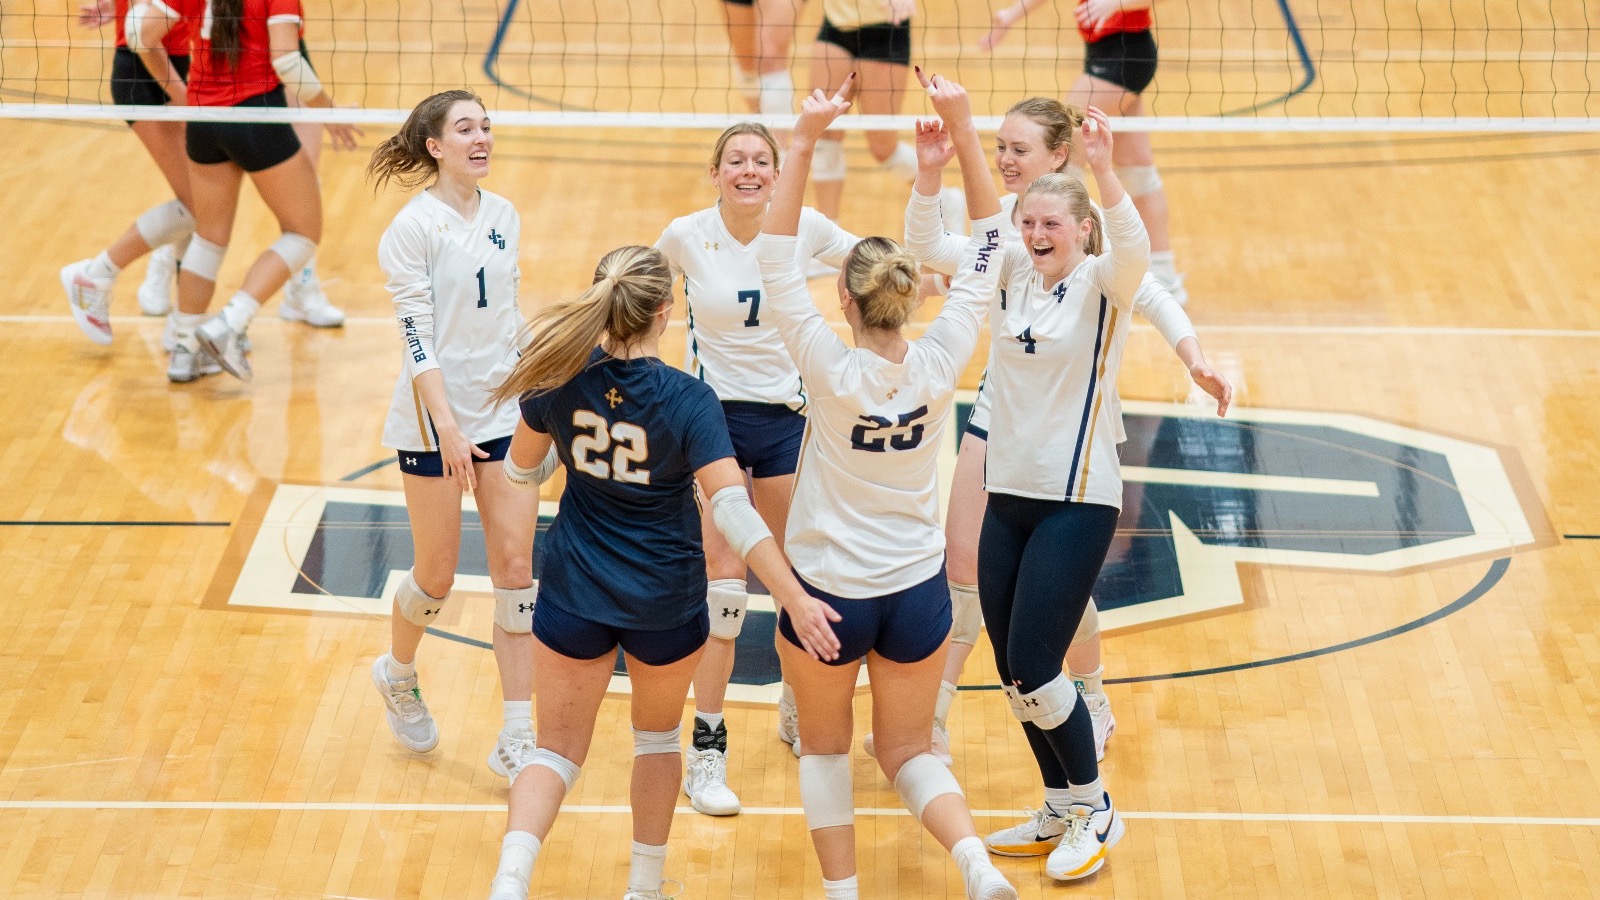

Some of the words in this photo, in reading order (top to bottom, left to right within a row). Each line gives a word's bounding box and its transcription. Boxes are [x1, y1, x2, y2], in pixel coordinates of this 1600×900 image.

[488, 228, 505, 250] JCU
[476, 266, 488, 309] 1
[738, 289, 761, 328] 7
[1015, 324, 1037, 354] 4
[571, 409, 650, 485] 22
[850, 404, 928, 452] 25
